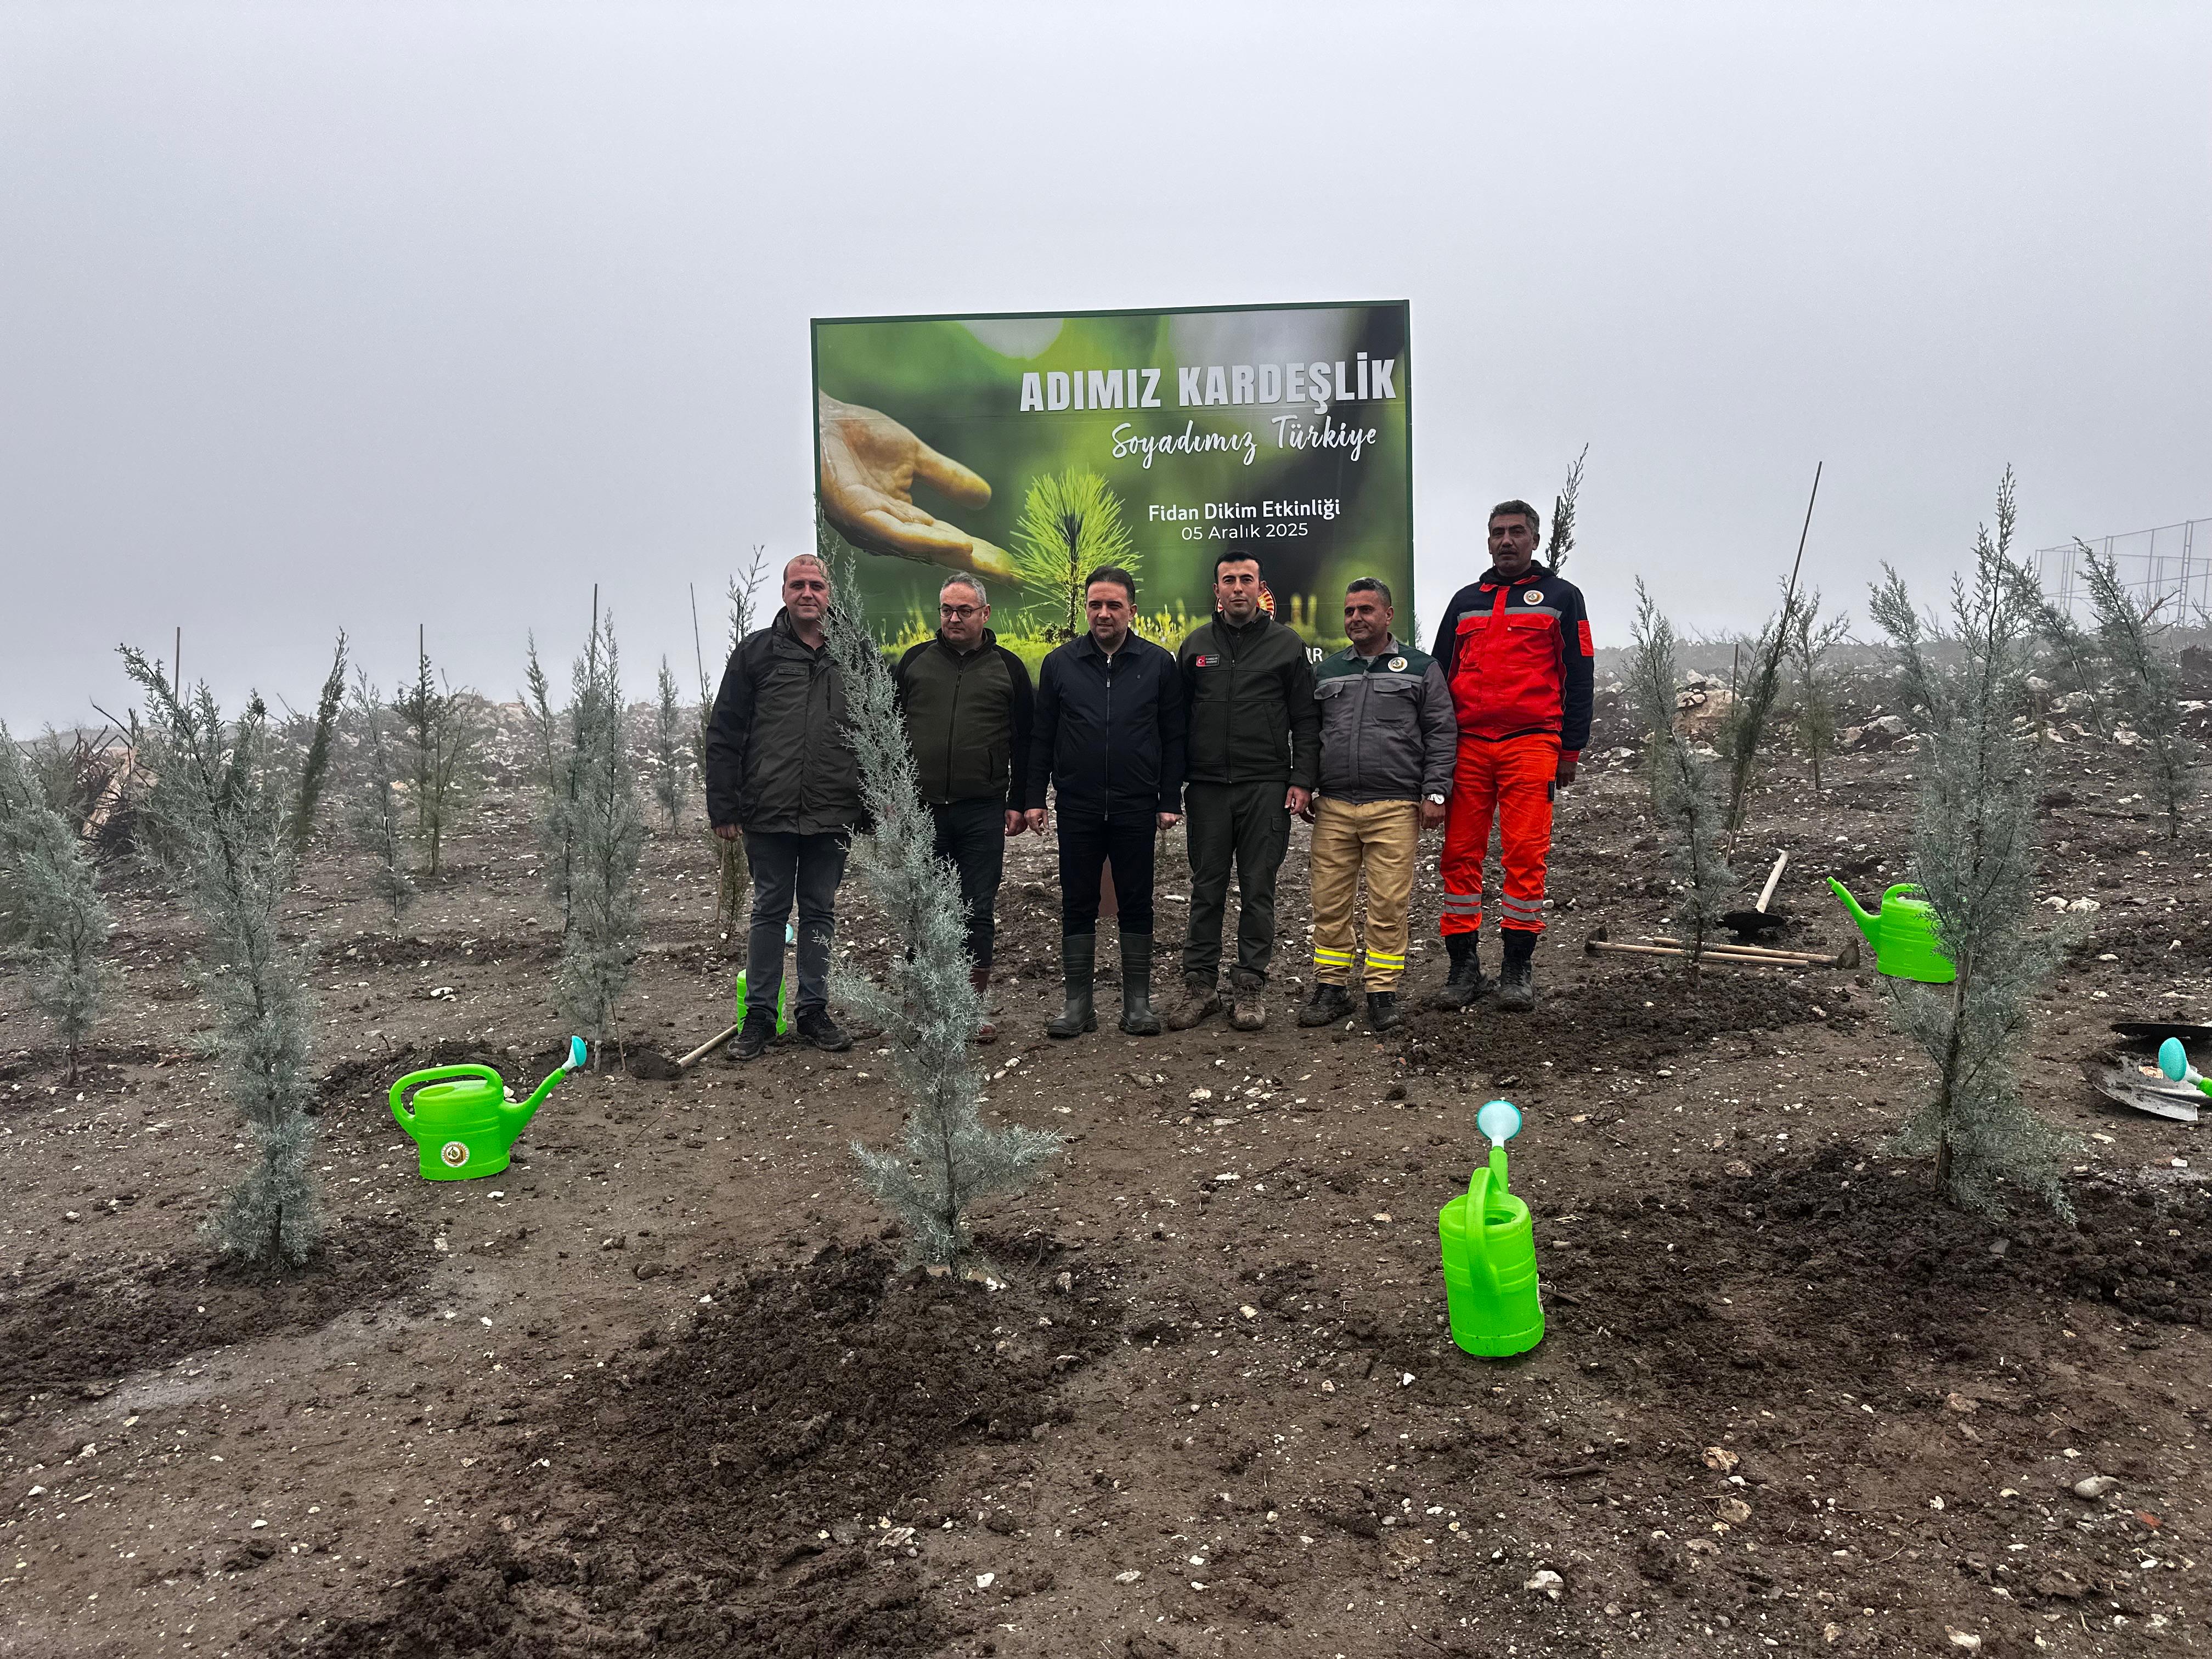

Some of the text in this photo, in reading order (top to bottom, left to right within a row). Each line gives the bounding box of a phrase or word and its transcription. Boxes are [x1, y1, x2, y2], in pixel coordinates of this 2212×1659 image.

[1020, 352, 1397, 415] ADIMIZ KARDEŞLİK
[1111, 414, 1376, 469] Soyadımız Türkiye
[1149, 499, 1340, 522] Fidan Dikim Etkinliği
[1181, 523, 1308, 540] 05 Aralık 2025
